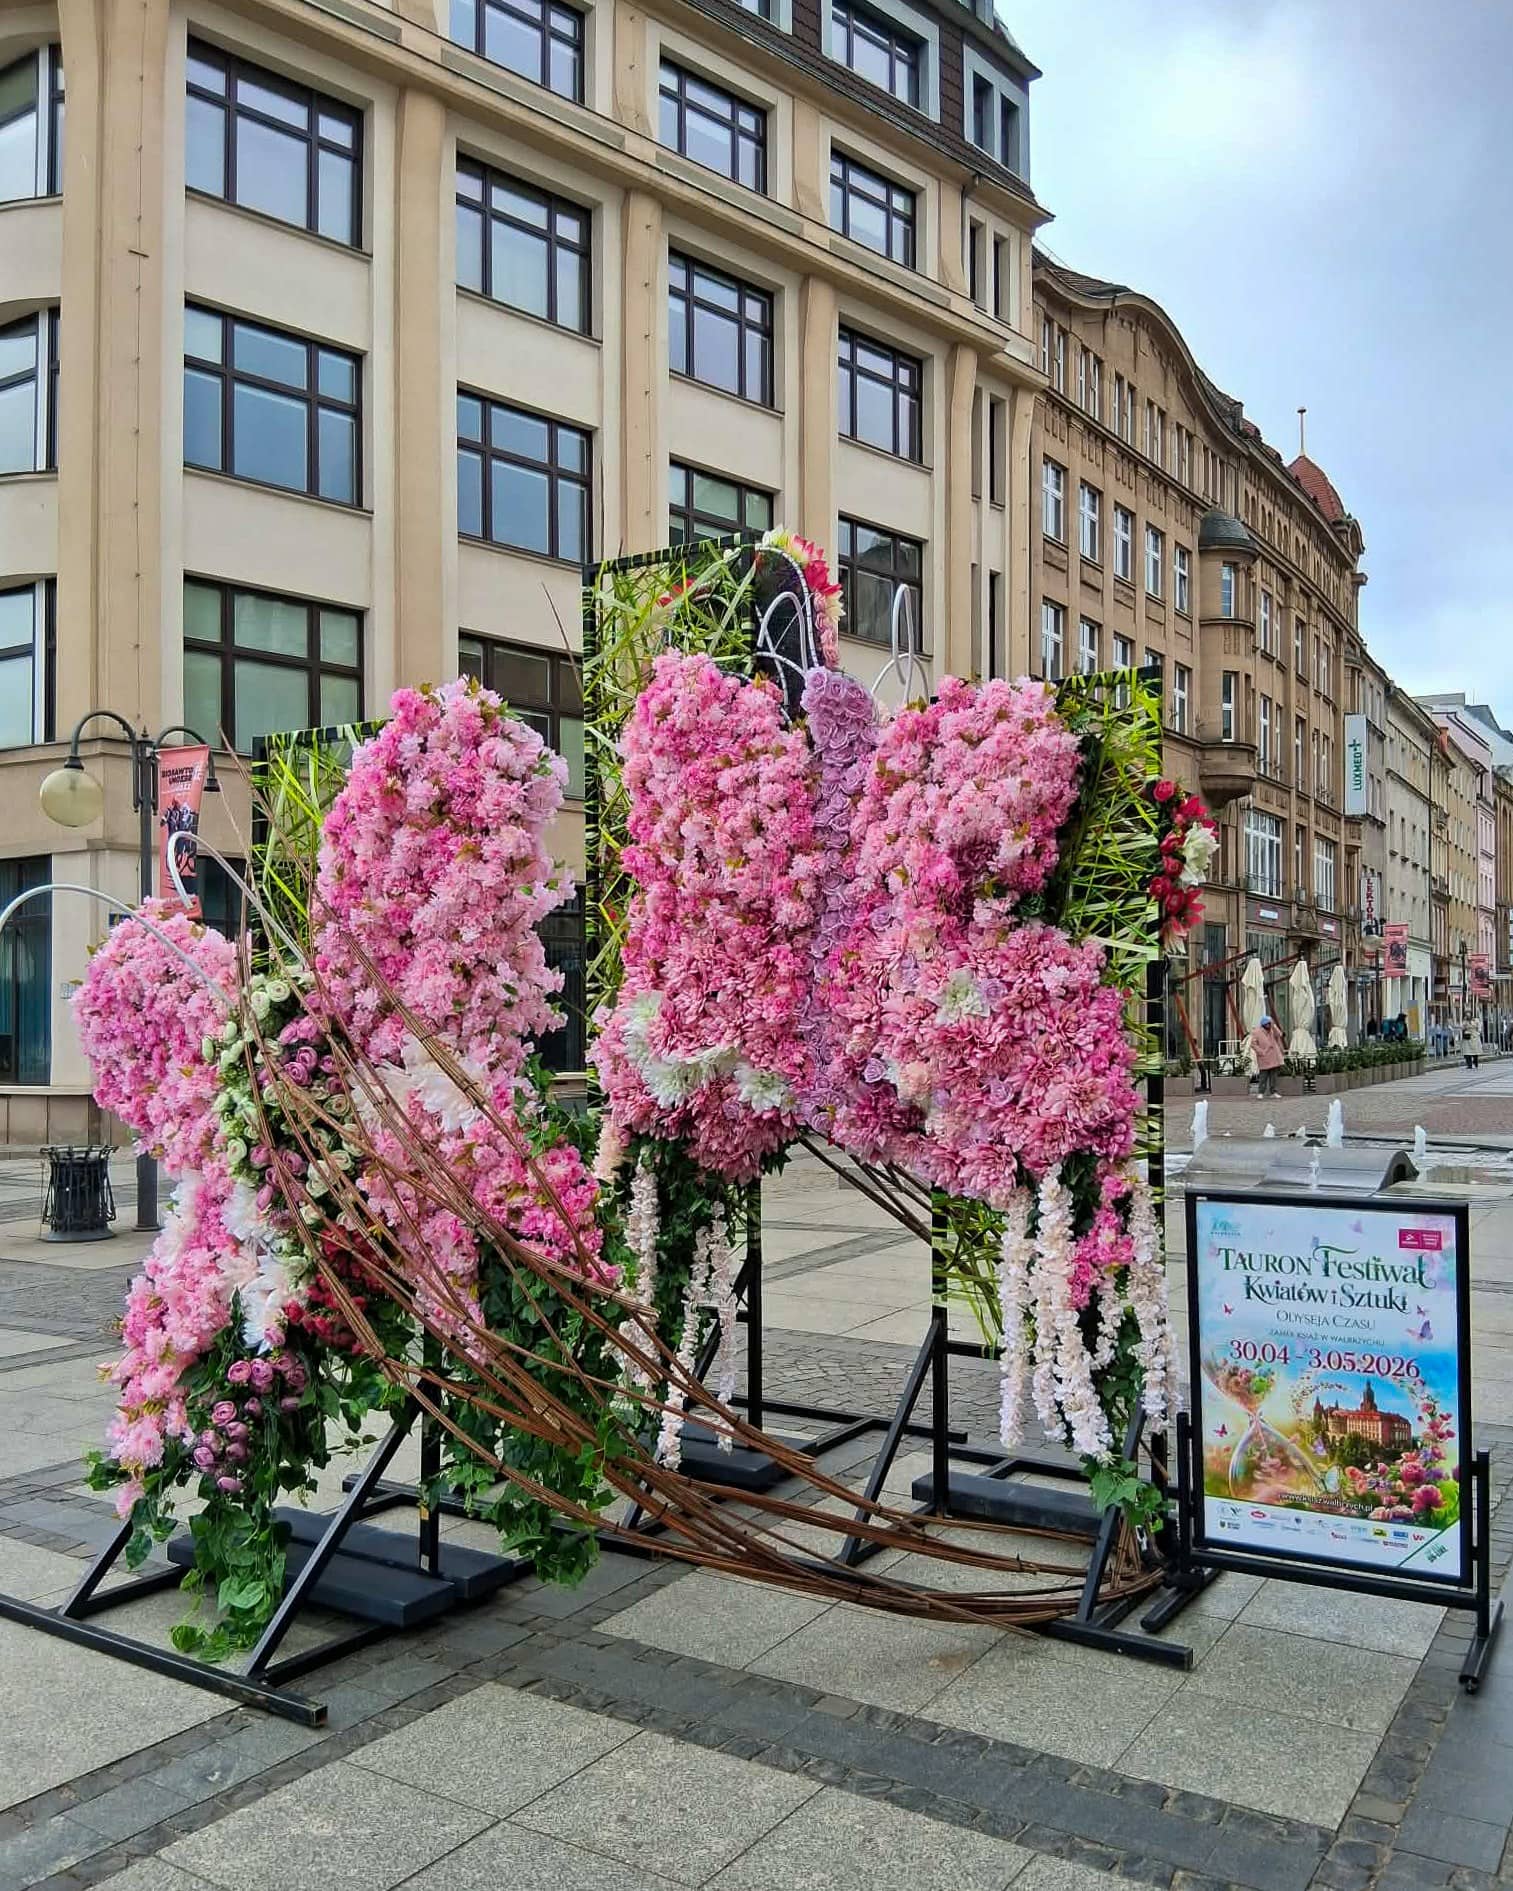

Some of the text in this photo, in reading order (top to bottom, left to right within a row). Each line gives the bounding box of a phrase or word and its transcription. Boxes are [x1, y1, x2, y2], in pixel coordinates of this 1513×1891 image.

[1217, 1245, 1436, 1289] TAURON Festiwal
[1243, 1275, 1410, 1314] Kwiatów i Sztuki
[1276, 1310, 1376, 1330] ODYSEJA CZASU
[1229, 1339, 1290, 1366] 30.04
[1308, 1347, 1421, 1379] 3.05.2026
